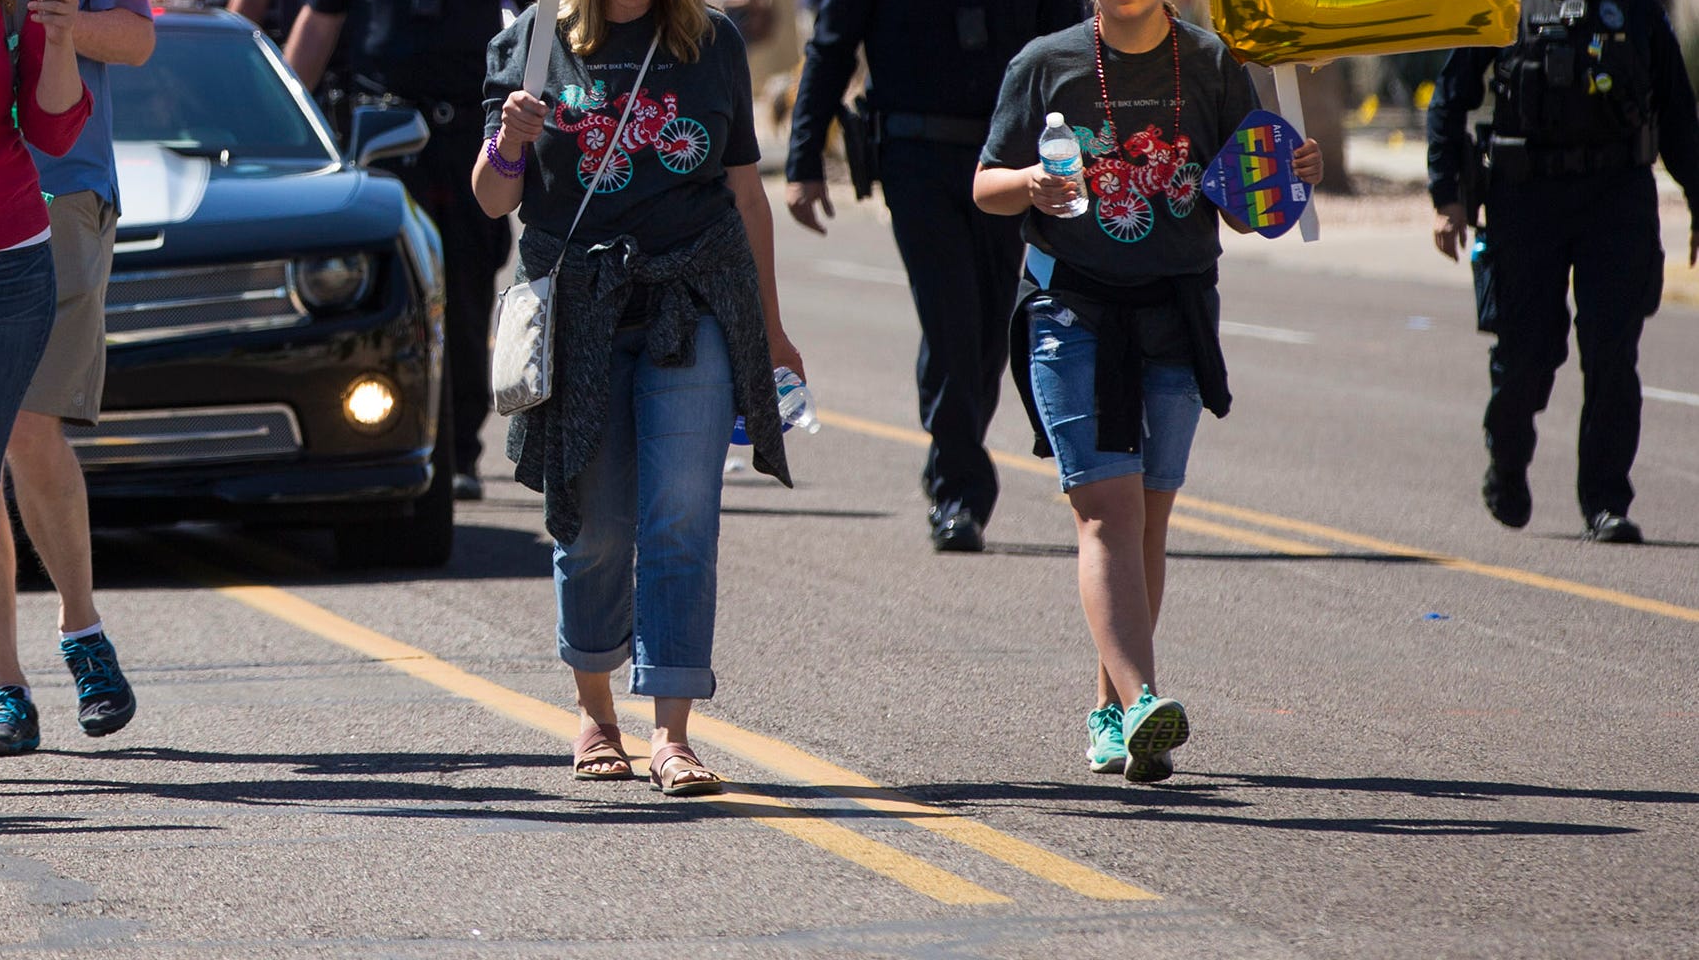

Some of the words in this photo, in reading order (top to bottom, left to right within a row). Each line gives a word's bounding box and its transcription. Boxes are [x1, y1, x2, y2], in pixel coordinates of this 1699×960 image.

[1095, 100, 1116, 109] TEPE
[1134, 99, 1159, 107] MONTH
[1224, 125, 1285, 228] FAN
